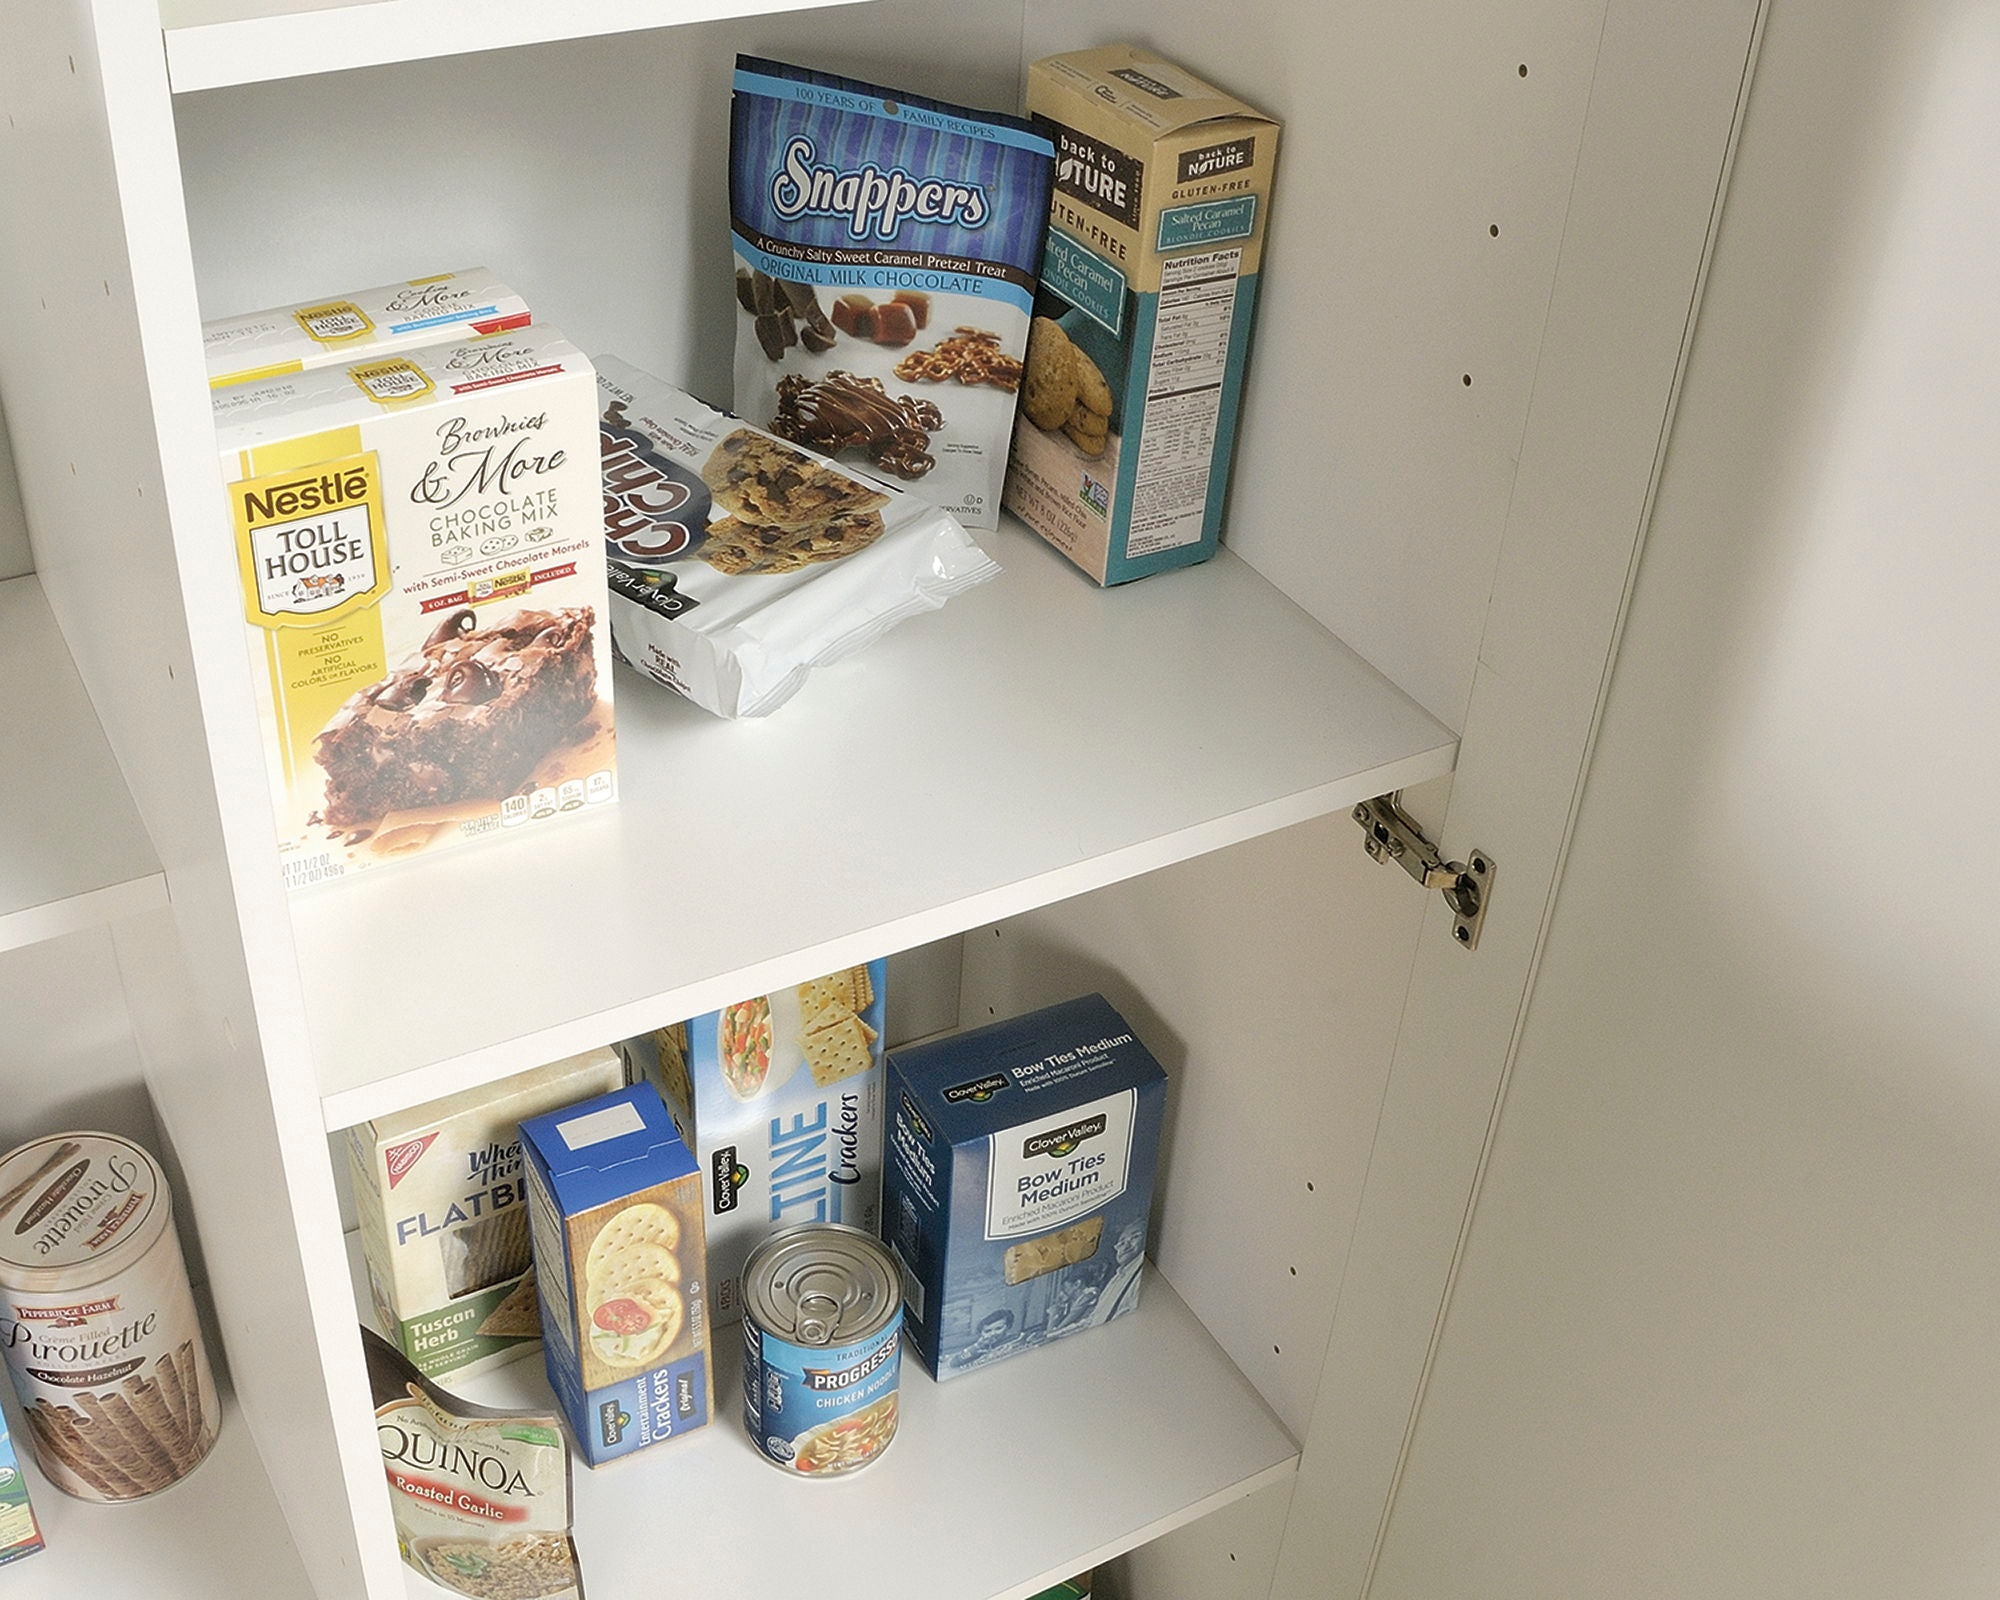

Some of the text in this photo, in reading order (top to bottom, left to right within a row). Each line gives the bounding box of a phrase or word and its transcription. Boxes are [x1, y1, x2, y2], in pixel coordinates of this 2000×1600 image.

[795, 86, 996, 139] 100 YEARS OF FAMILY RECIPES
[1060, 135, 1116, 173] back to
[1199, 150, 1223, 160] back
[773, 141, 984, 234] Snappers
[1172, 180, 1250, 199] GLUTEN-FREE
[1051, 204, 1126, 261] UTEN-FREE
[1172, 204, 1244, 226] Salted Caramel
[1192, 220, 1222, 232] Pecan
[757, 237, 1007, 278] A Crunchy Salty Sweet Caramel Pretzel Treat
[761, 257, 983, 294] ORIGINAL MILK CHOCOLATE
[1057, 259, 1089, 292] Pecan
[1071, 249, 1113, 293] Caramel
[1165, 250, 1239, 270] Nutrition Facts
[436, 412, 549, 457] Brownies
[410, 437, 568, 511] & More
[244, 466, 368, 523] Nestlé
[429, 487, 559, 533] CHOCOLATE
[276, 521, 349, 554] TOLL
[432, 502, 559, 548] BAKING MIX
[264, 539, 366, 581] HOUSE
[402, 539, 590, 595] with Semi-Sweet Chocolate Morsels
[607, 565, 636, 587] Valle
[298, 636, 364, 657] PRESERVATIVES
[321, 633, 339, 643] NO
[291, 663, 377, 689] COLORS FLAVORS
[311, 660, 356, 676] ARTIFICIAL
[324, 655, 342, 665] NO
[504, 798, 525, 813] 140
[1011, 1033, 1133, 1079] Bow Ties Medium
[1019, 1053, 1109, 1087] Enriched Macaroni Product
[949, 1085, 978, 1099] Clover
[828, 1093, 861, 1185] Crackers
[1029, 1123, 1099, 1151] Clover Valley
[1018, 1153, 1105, 1192] Bow Ties
[1021, 1171, 1099, 1207] Medium
[33, 1155, 137, 1254] Pirouette
[1002, 1180, 1114, 1225] Enriched Macaroni Product
[21, 1302, 112, 1318] PEPPERIDGE FARM
[410, 1307, 476, 1337] Tuscan
[0, 1312, 156, 1362] Pirouette
[80, 1327, 110, 1342] Filled
[413, 1330, 459, 1352] Herb
[837, 1335, 887, 1361] TRADITIONAL
[38, 1364, 132, 1383] Chocolate Hazelnut
[814, 1332, 898, 1389] PROGRESSO
[650, 1369, 672, 1440] Crackers
[678, 1379, 693, 1412] Original
[816, 1390, 864, 1408] CHICKEN
[867, 1365, 897, 1394] NOODLE
[636, 1376, 651, 1447] Entertainment
[377, 1424, 537, 1498] QUINOA
[396, 1476, 503, 1519] Roasted Garlic
